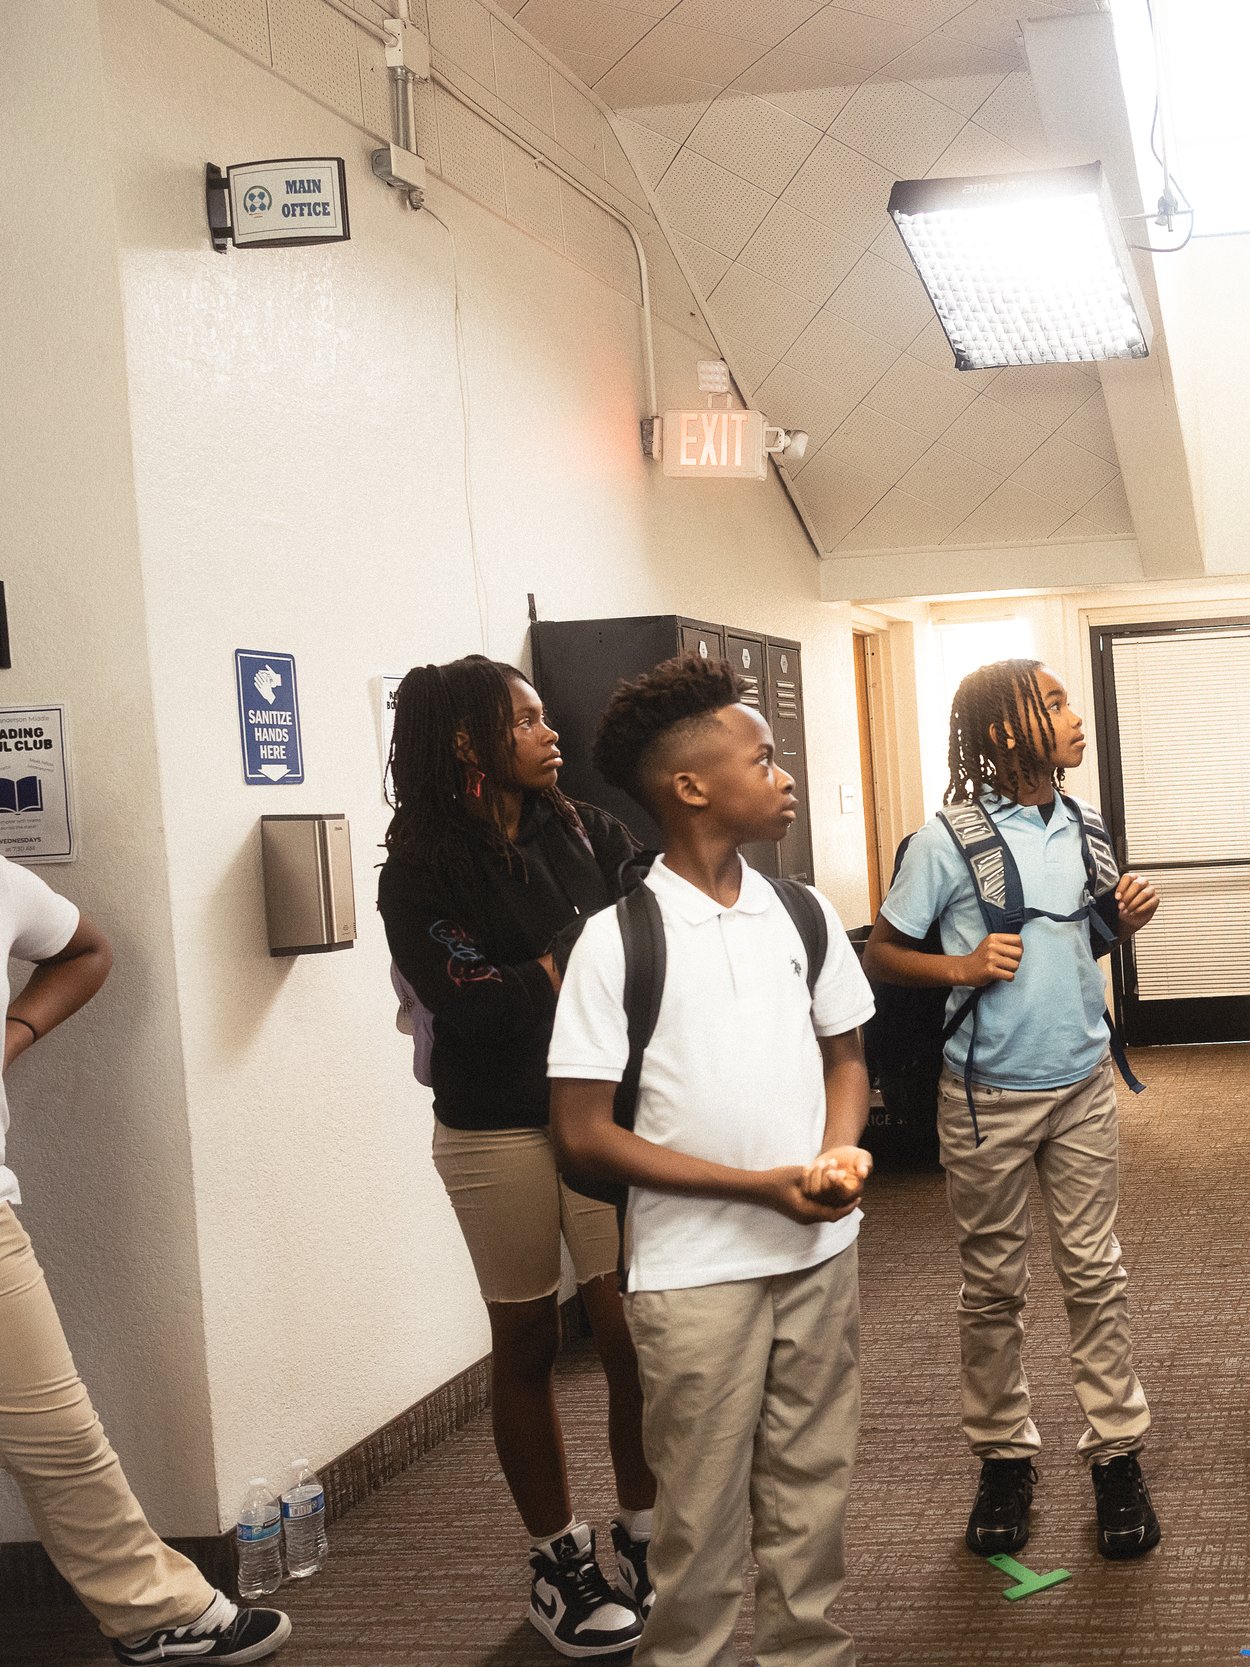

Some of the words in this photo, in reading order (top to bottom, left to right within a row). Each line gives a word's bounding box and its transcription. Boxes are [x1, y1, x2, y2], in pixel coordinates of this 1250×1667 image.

[285, 179, 322, 194] MAIN
[281, 201, 331, 218] OFFICE
[680, 413, 749, 466] EXIT
[248, 709, 293, 725] SANITIZE
[254, 727, 289, 742] HANDS
[14, 739, 53, 751] CLUB
[259, 745, 287, 759] HERE
